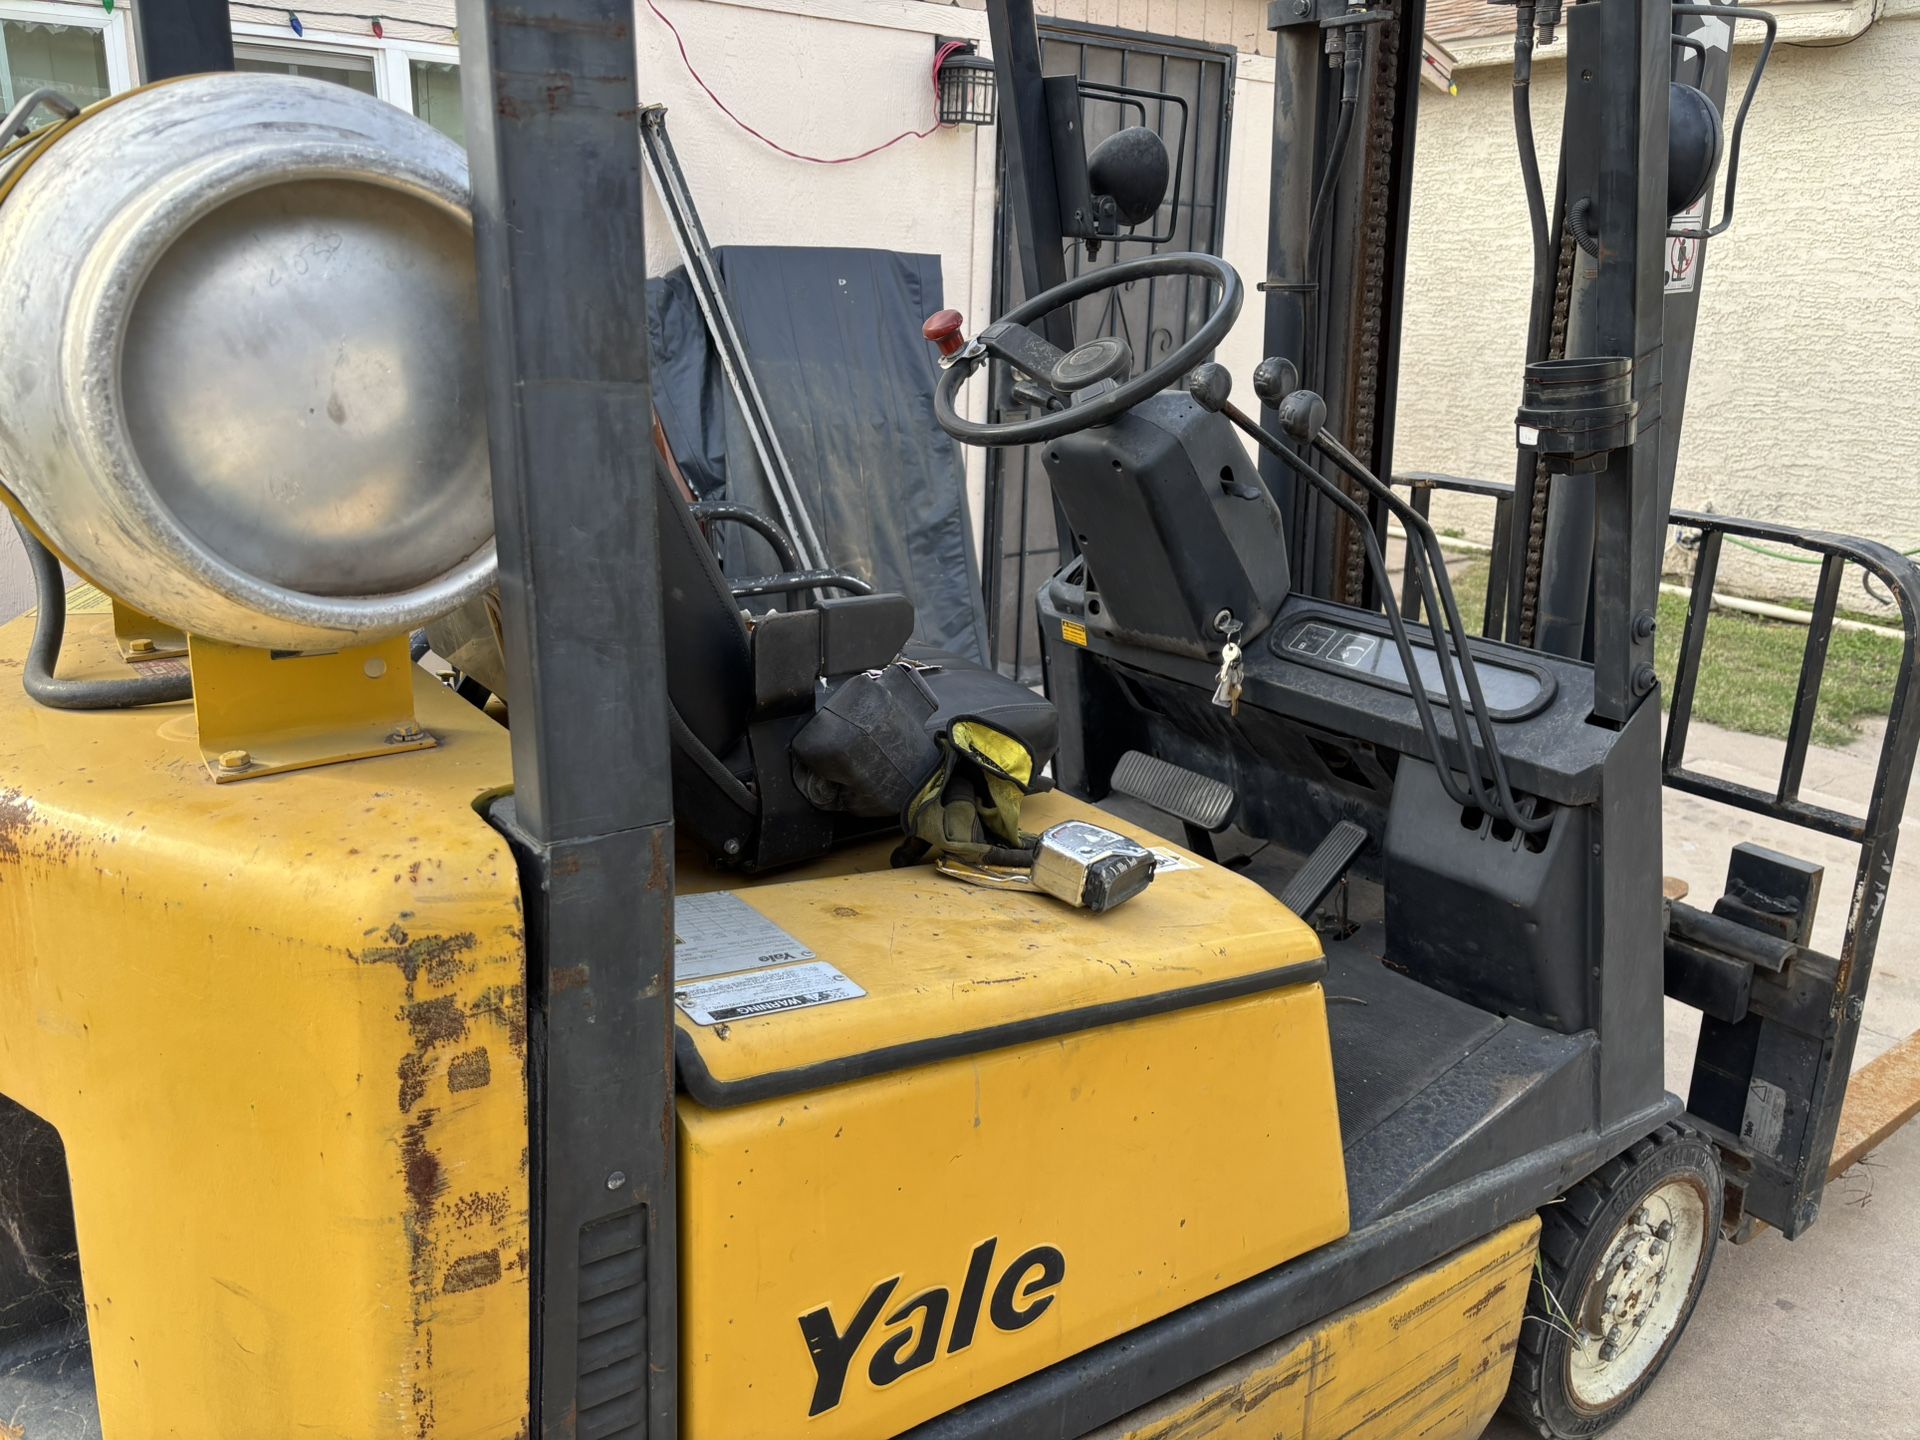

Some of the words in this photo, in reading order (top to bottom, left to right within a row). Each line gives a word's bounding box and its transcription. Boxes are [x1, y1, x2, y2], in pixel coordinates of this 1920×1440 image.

[759, 952, 796, 963] Yale
[737, 997, 802, 1015] WARNING
[798, 1237, 1066, 1417] Yale
